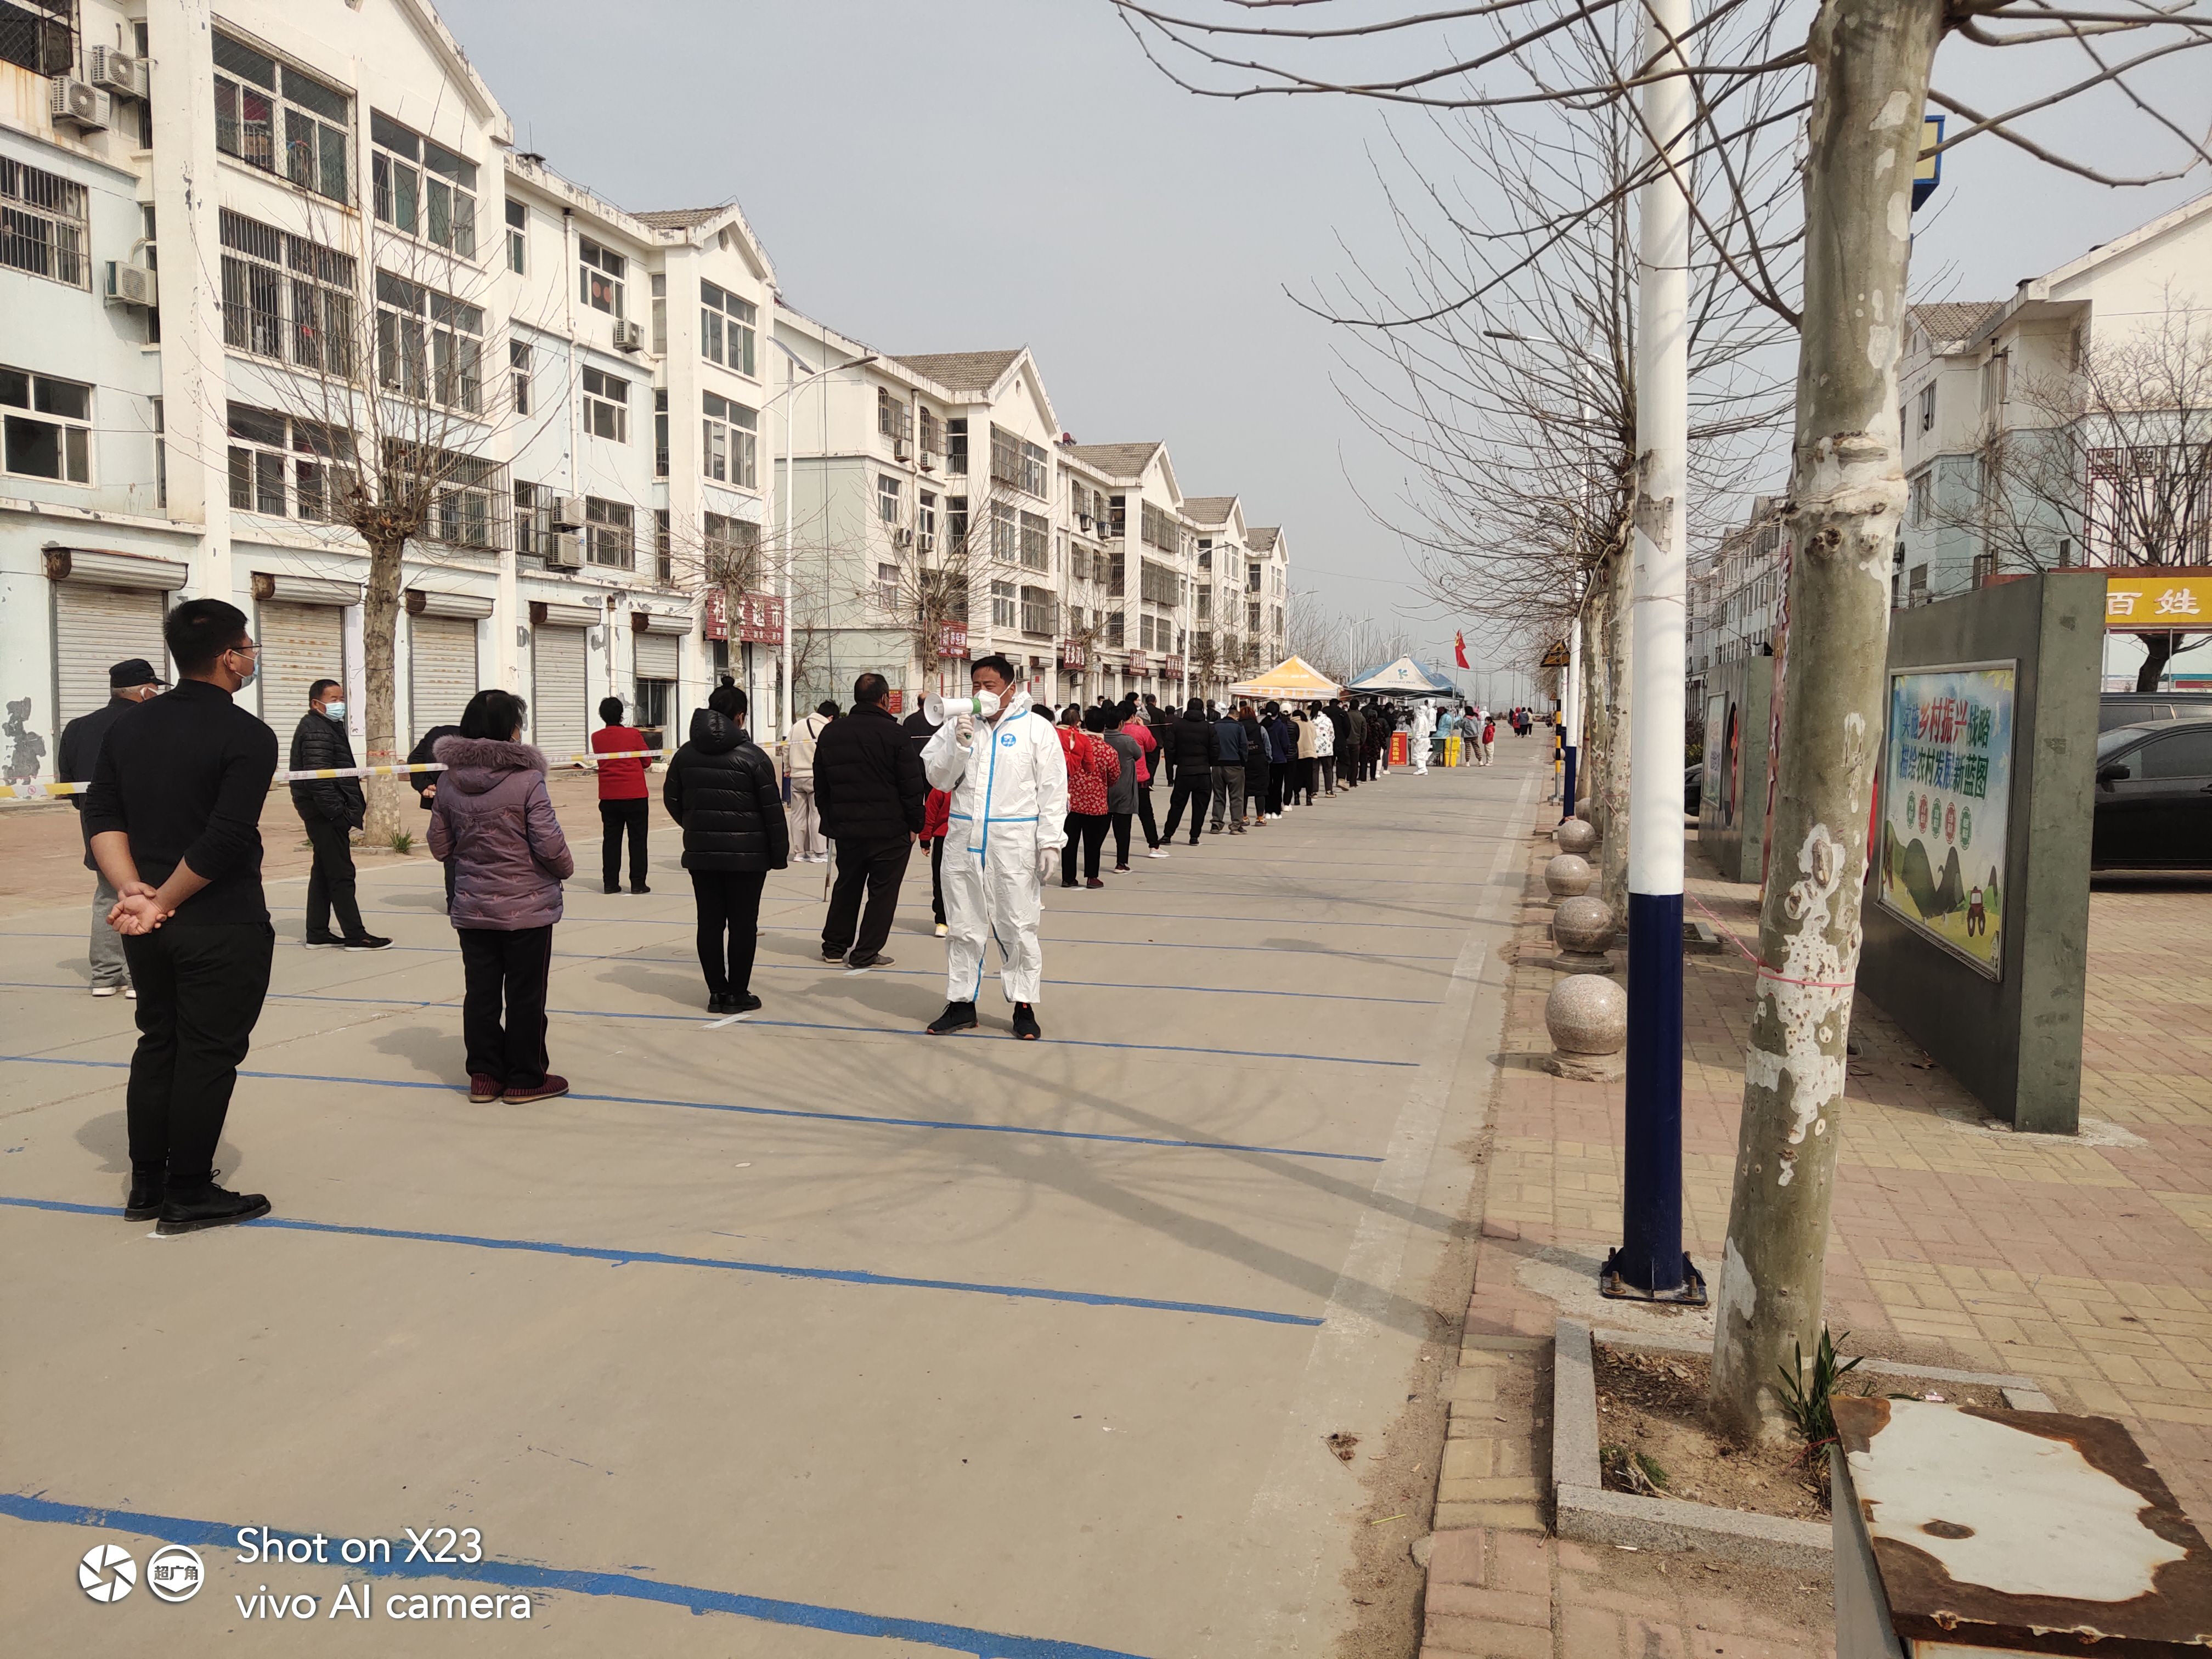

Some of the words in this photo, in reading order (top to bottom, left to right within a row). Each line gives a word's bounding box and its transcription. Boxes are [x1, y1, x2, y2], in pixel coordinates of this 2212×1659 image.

[2106, 588, 2201, 616] 百姓
[1902, 697, 1992, 749] 实施乡村振兴战略
[1900, 742, 1989, 800] 描绘农村发展新蓝图
